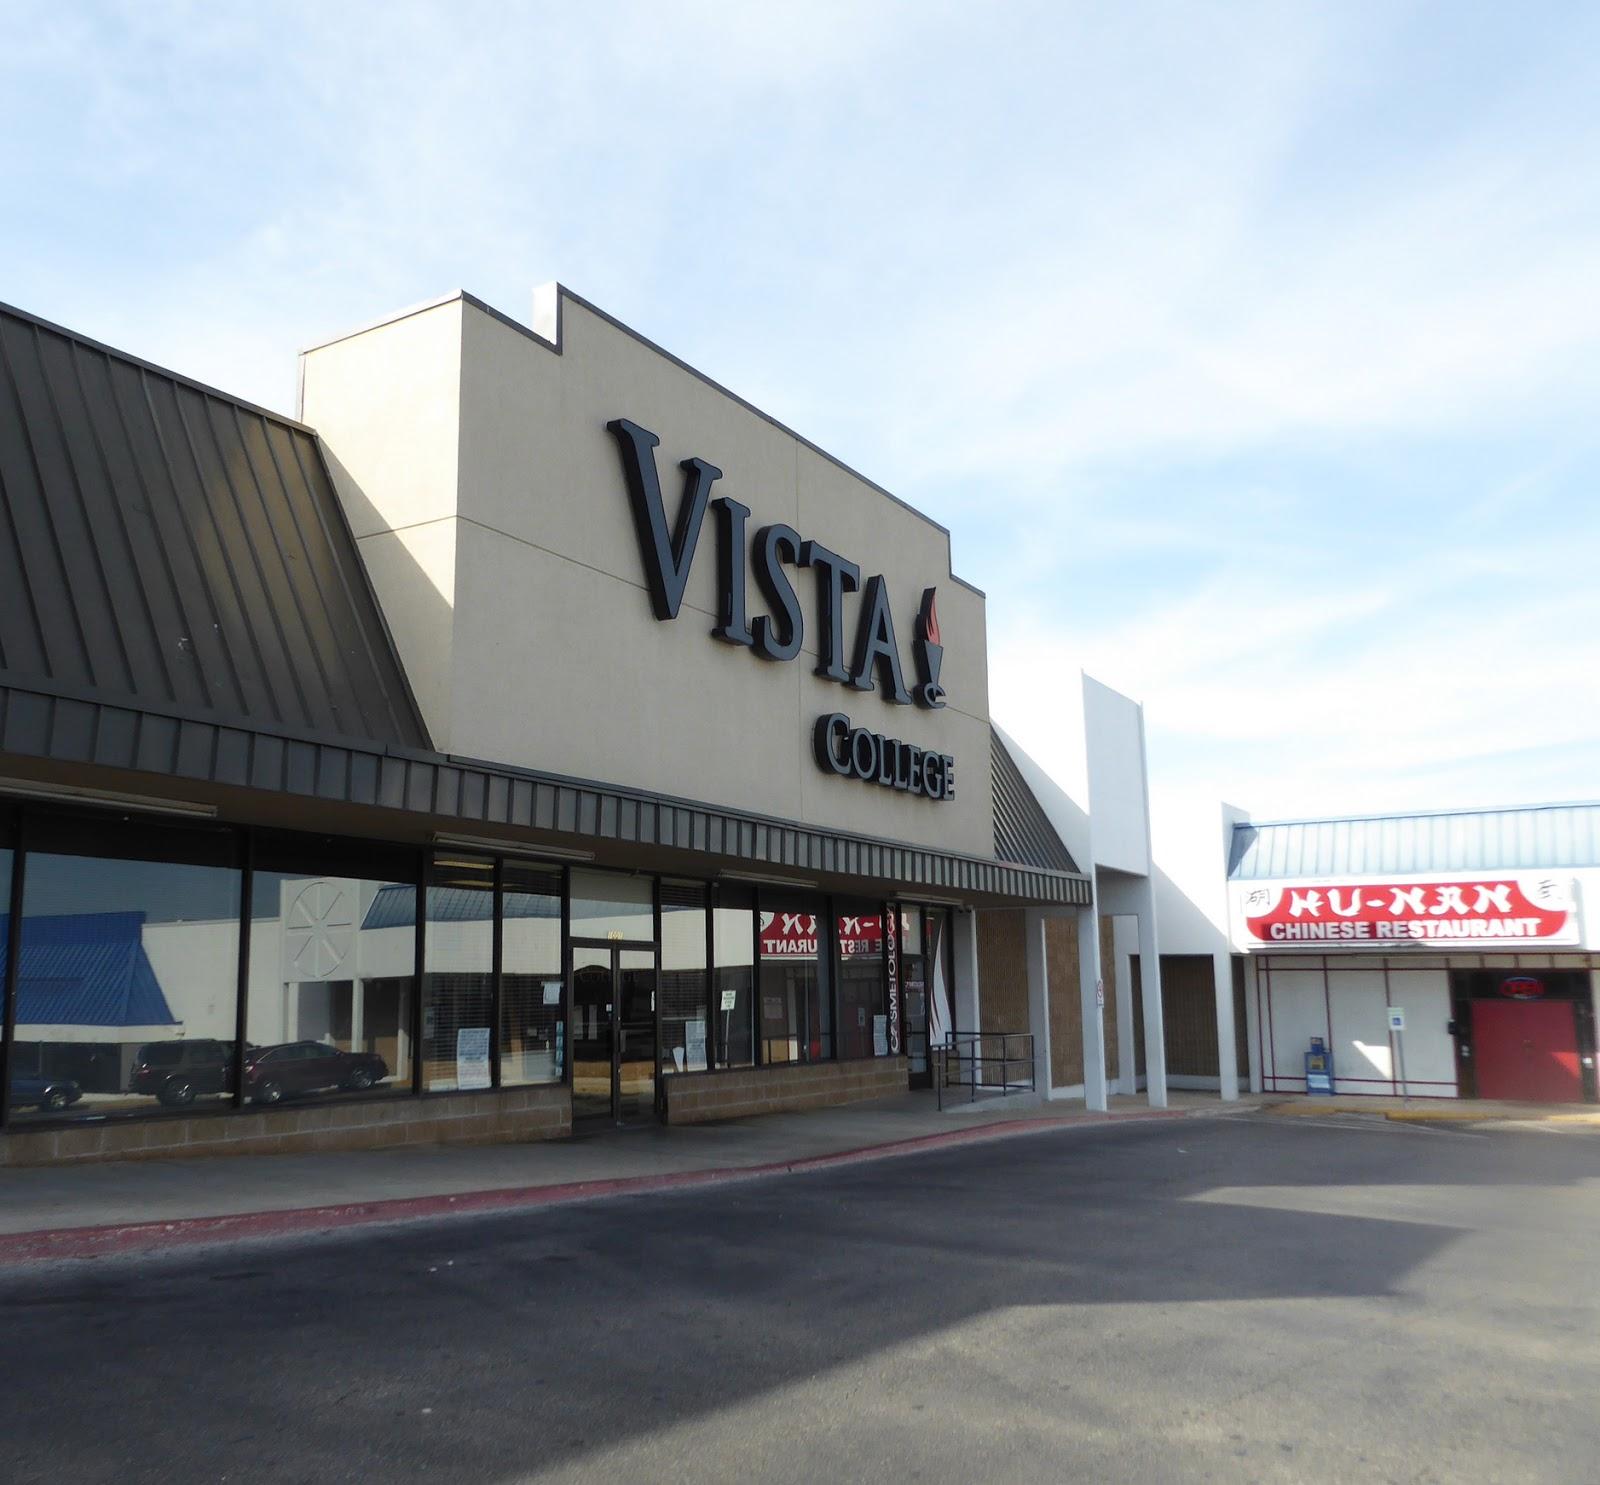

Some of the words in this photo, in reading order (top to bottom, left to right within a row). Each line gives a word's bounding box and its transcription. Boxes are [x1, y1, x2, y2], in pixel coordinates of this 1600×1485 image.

[606, 418, 912, 705] VISTA
[814, 712, 955, 801] COLLEGE
[1269, 921, 1370, 940] CHINESE
[1375, 917, 1542, 938] RESTAURANT
[1288, 884, 1513, 918] HU-NAN
